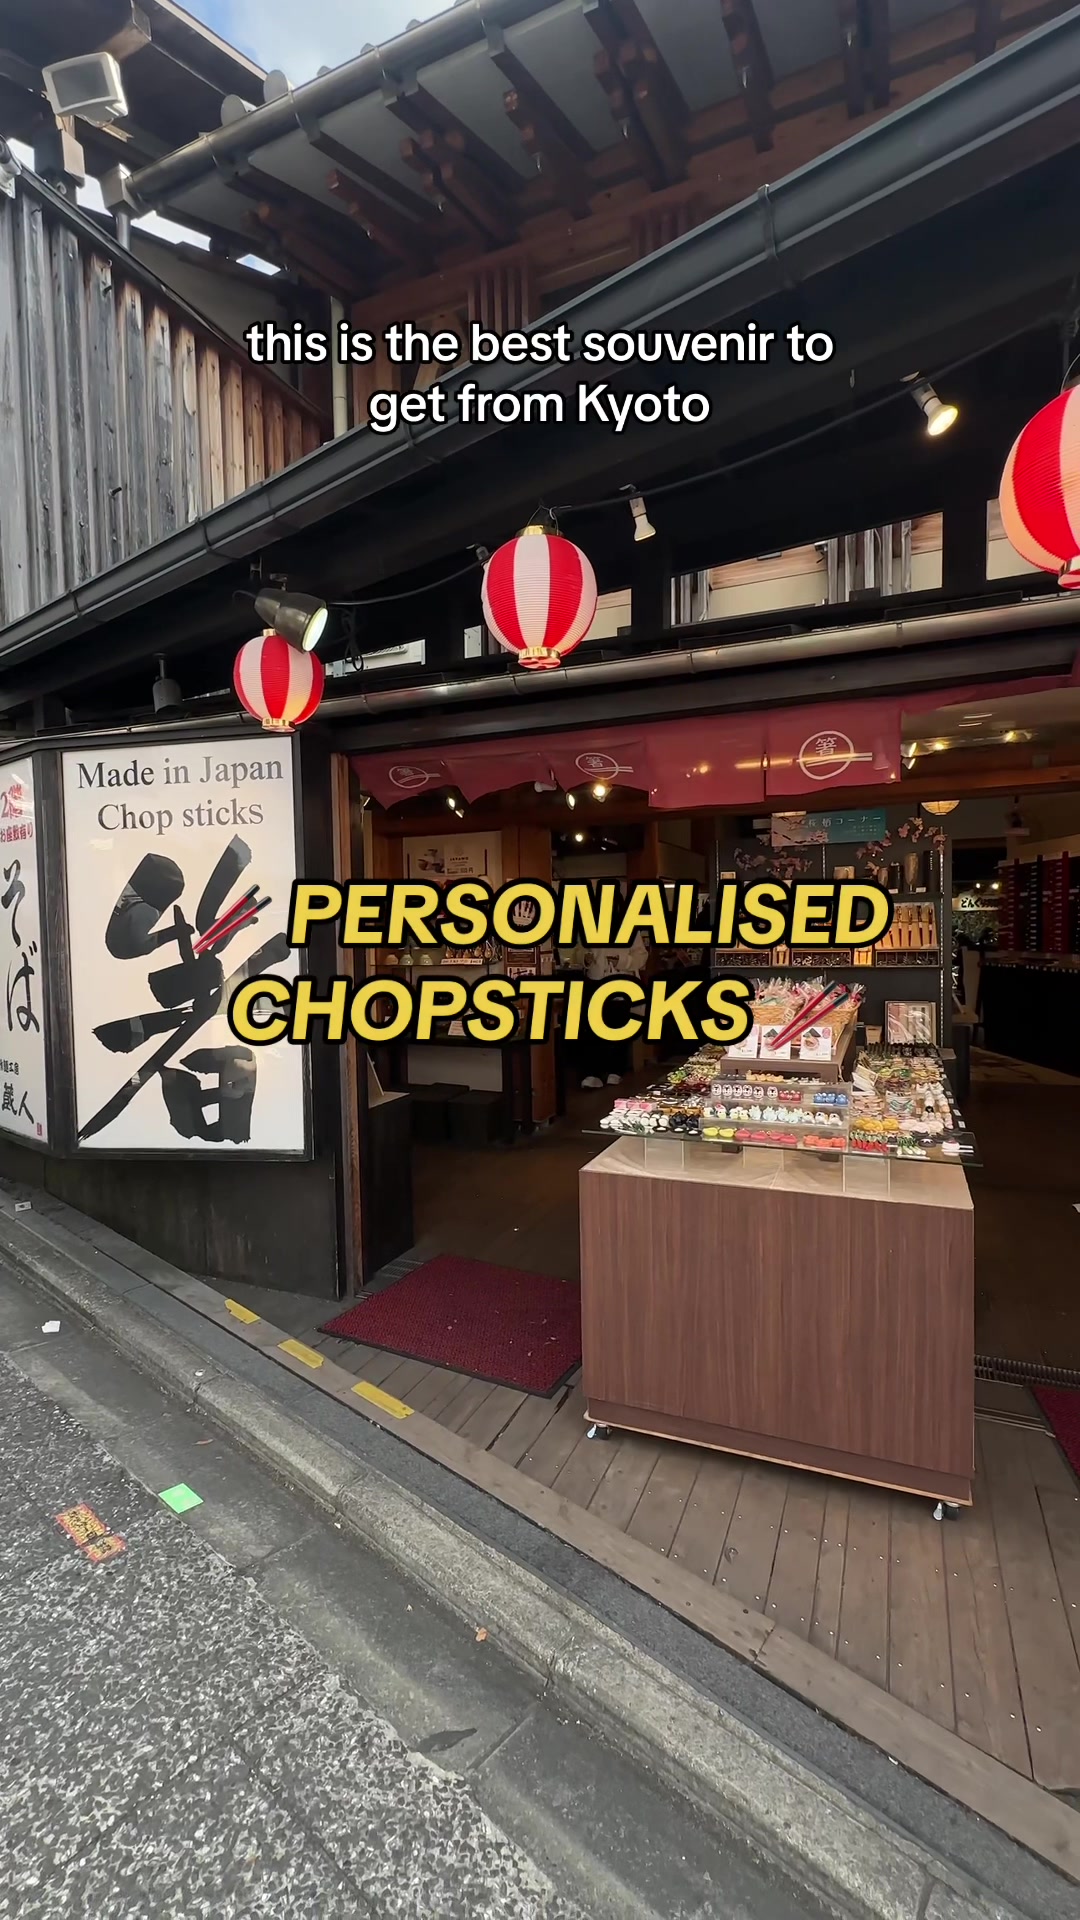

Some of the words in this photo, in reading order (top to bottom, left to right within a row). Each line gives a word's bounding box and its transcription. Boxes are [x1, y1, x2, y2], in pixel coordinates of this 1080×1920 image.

[815, 737, 837, 757] 箸
[77, 759, 155, 789] Made
[163, 757, 190, 785] in
[199, 755, 284, 789] Japan
[97, 802, 174, 836] Chop
[182, 798, 264, 827] sticks
[1, 858, 39, 1034] そば
